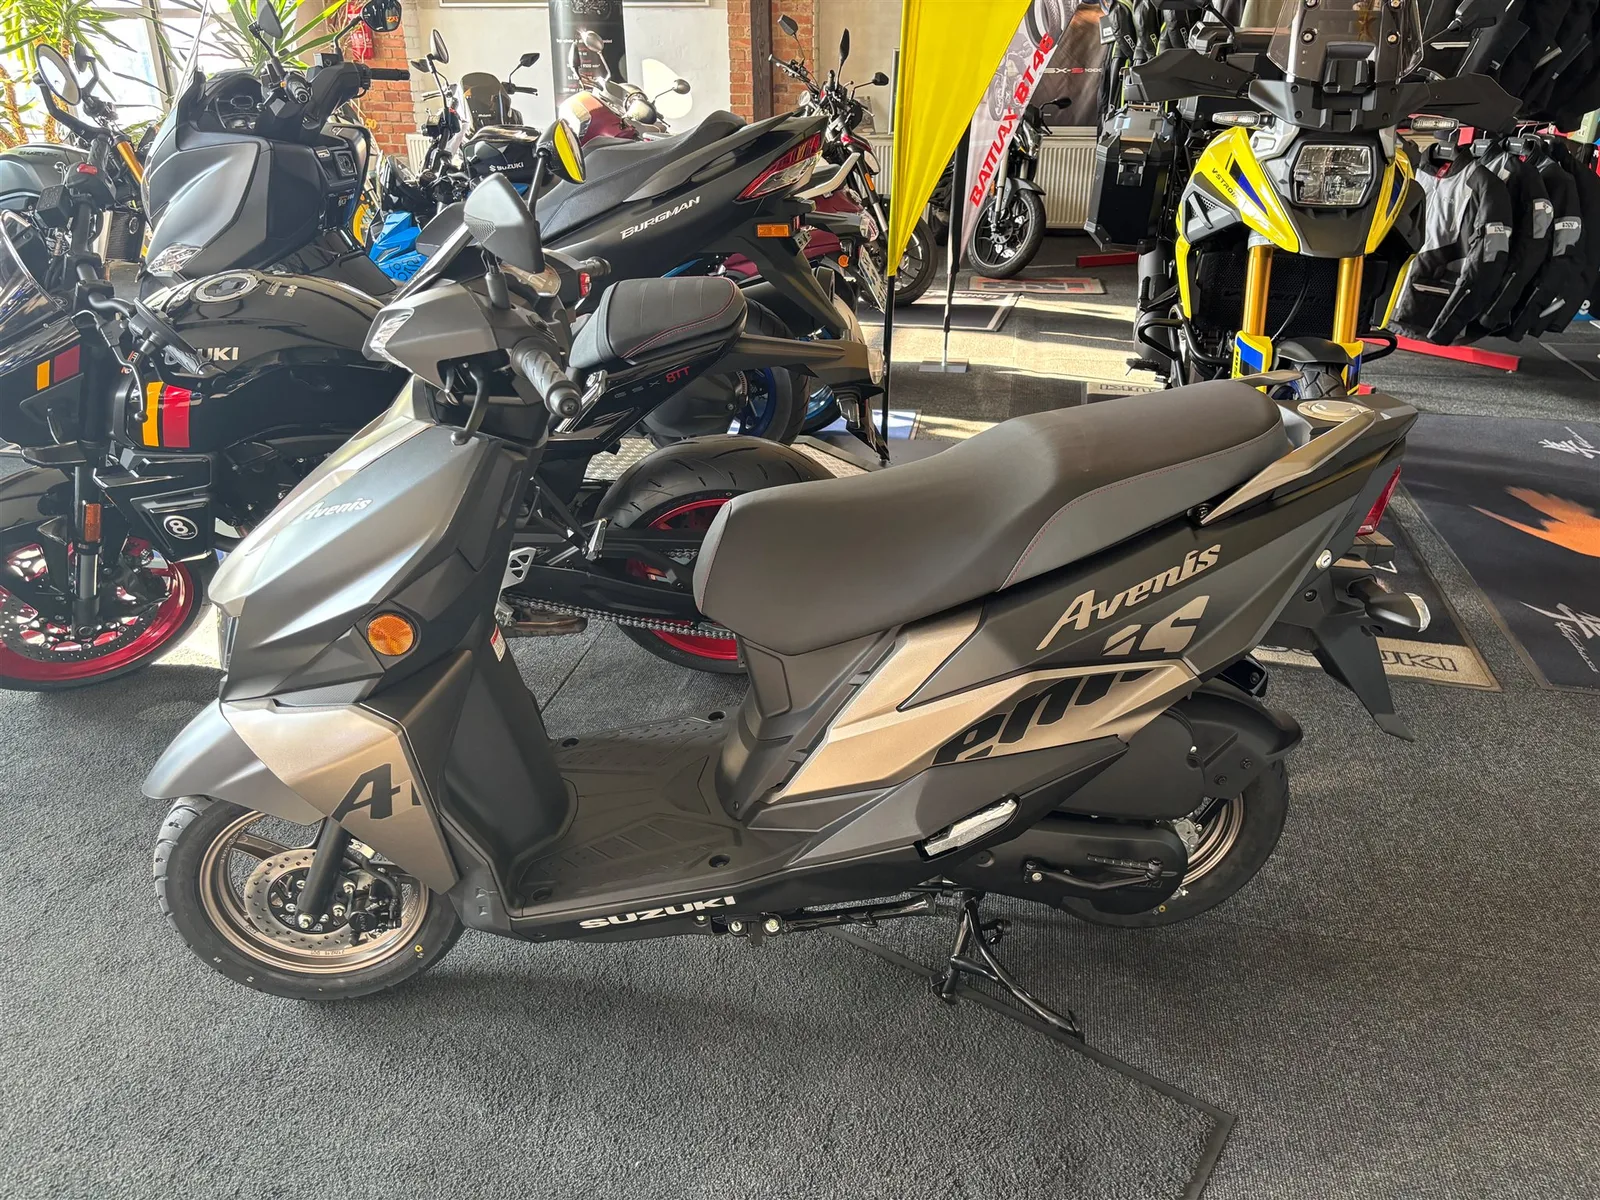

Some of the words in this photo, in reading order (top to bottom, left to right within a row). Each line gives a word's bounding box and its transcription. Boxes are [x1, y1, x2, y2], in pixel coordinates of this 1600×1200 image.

[969, 105, 1018, 207] BATTLAX
[1014, 32, 1054, 104] BT46
[496, 161, 524, 171] SUZUKI
[620, 195, 701, 240] BURGMAN
[169, 519, 189, 534] 8
[291, 497, 374, 526] Avenis
[1035, 543, 1221, 651] Avenis
[579, 895, 737, 929] SUZUKI
